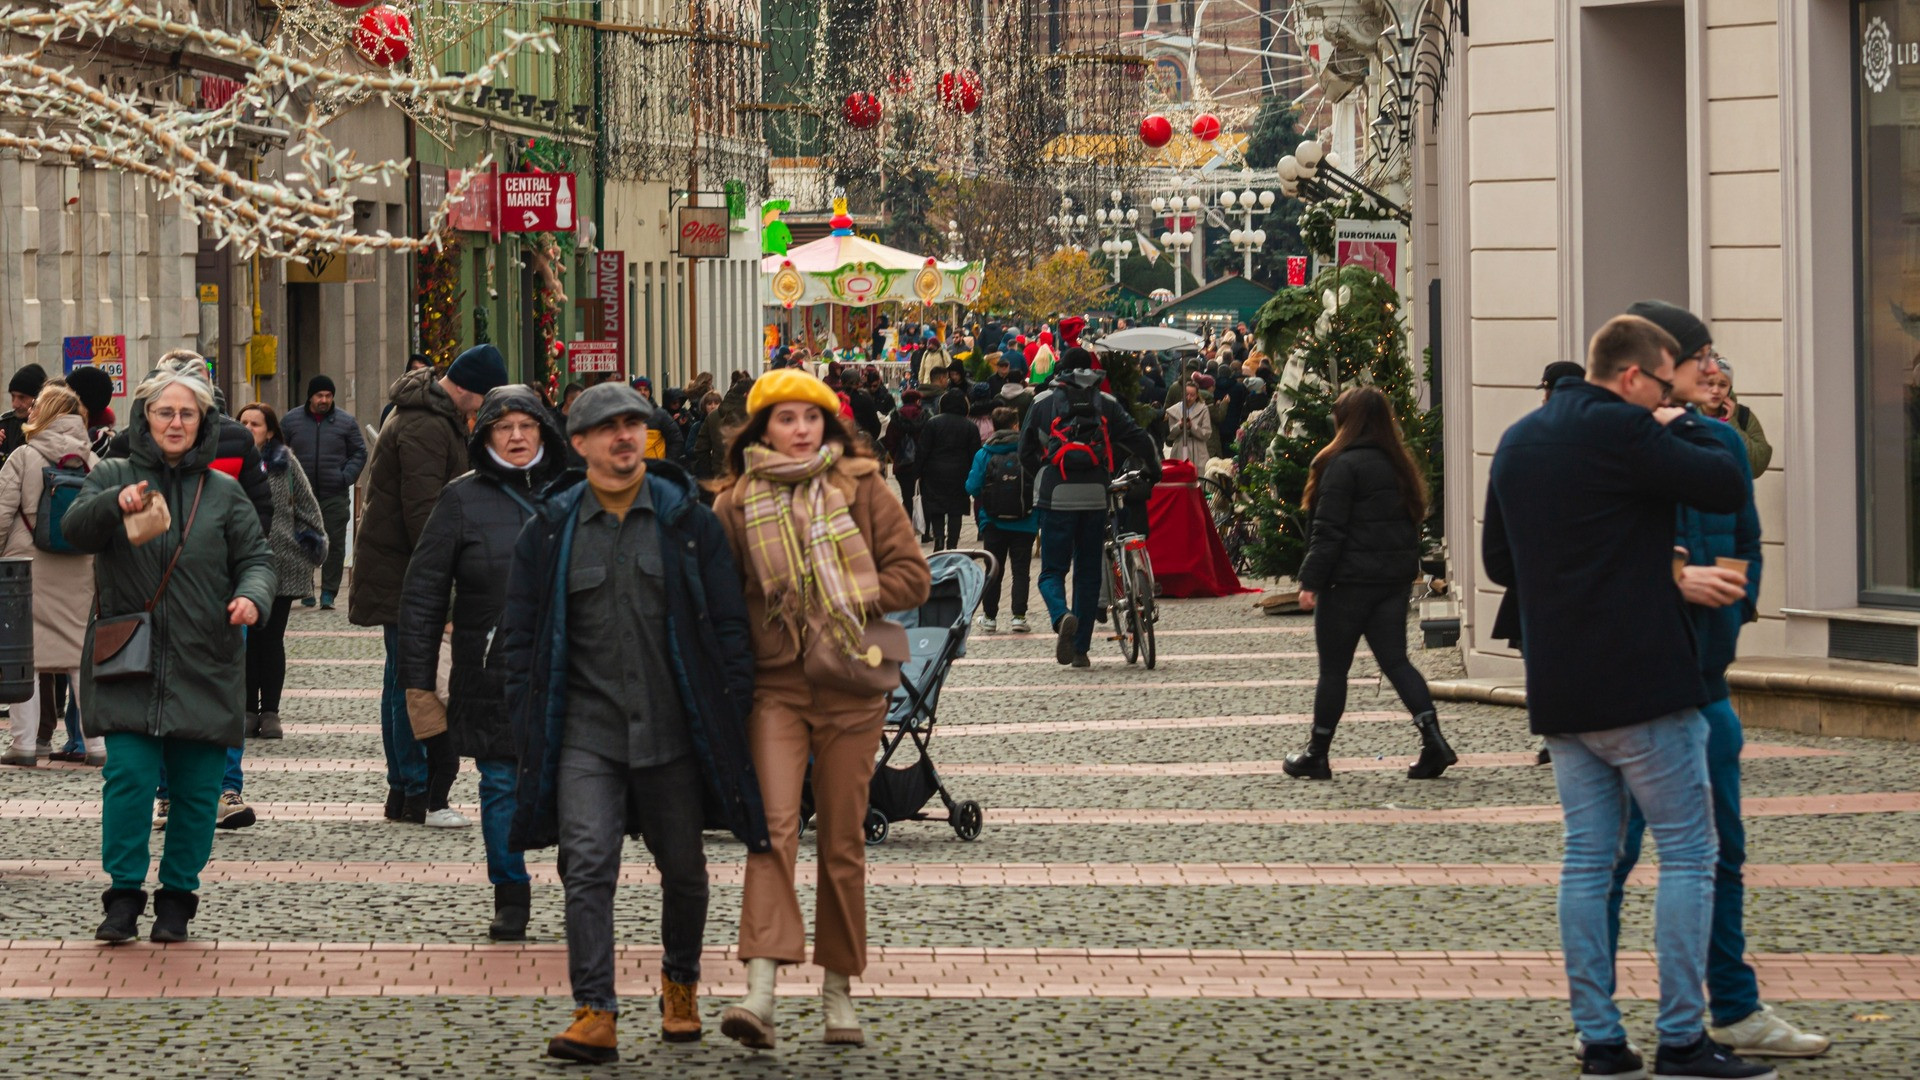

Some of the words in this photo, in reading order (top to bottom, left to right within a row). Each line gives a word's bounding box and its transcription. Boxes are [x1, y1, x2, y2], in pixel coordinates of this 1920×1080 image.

[505, 177, 552, 191] CENTRAL
[507, 192, 551, 207] MARKET
[681, 220, 726, 244] Optic
[1338, 231, 1397, 240] EUROTHALIA
[601, 253, 619, 331] EXCHANGE
[69, 336, 118, 347] SCHIMB
